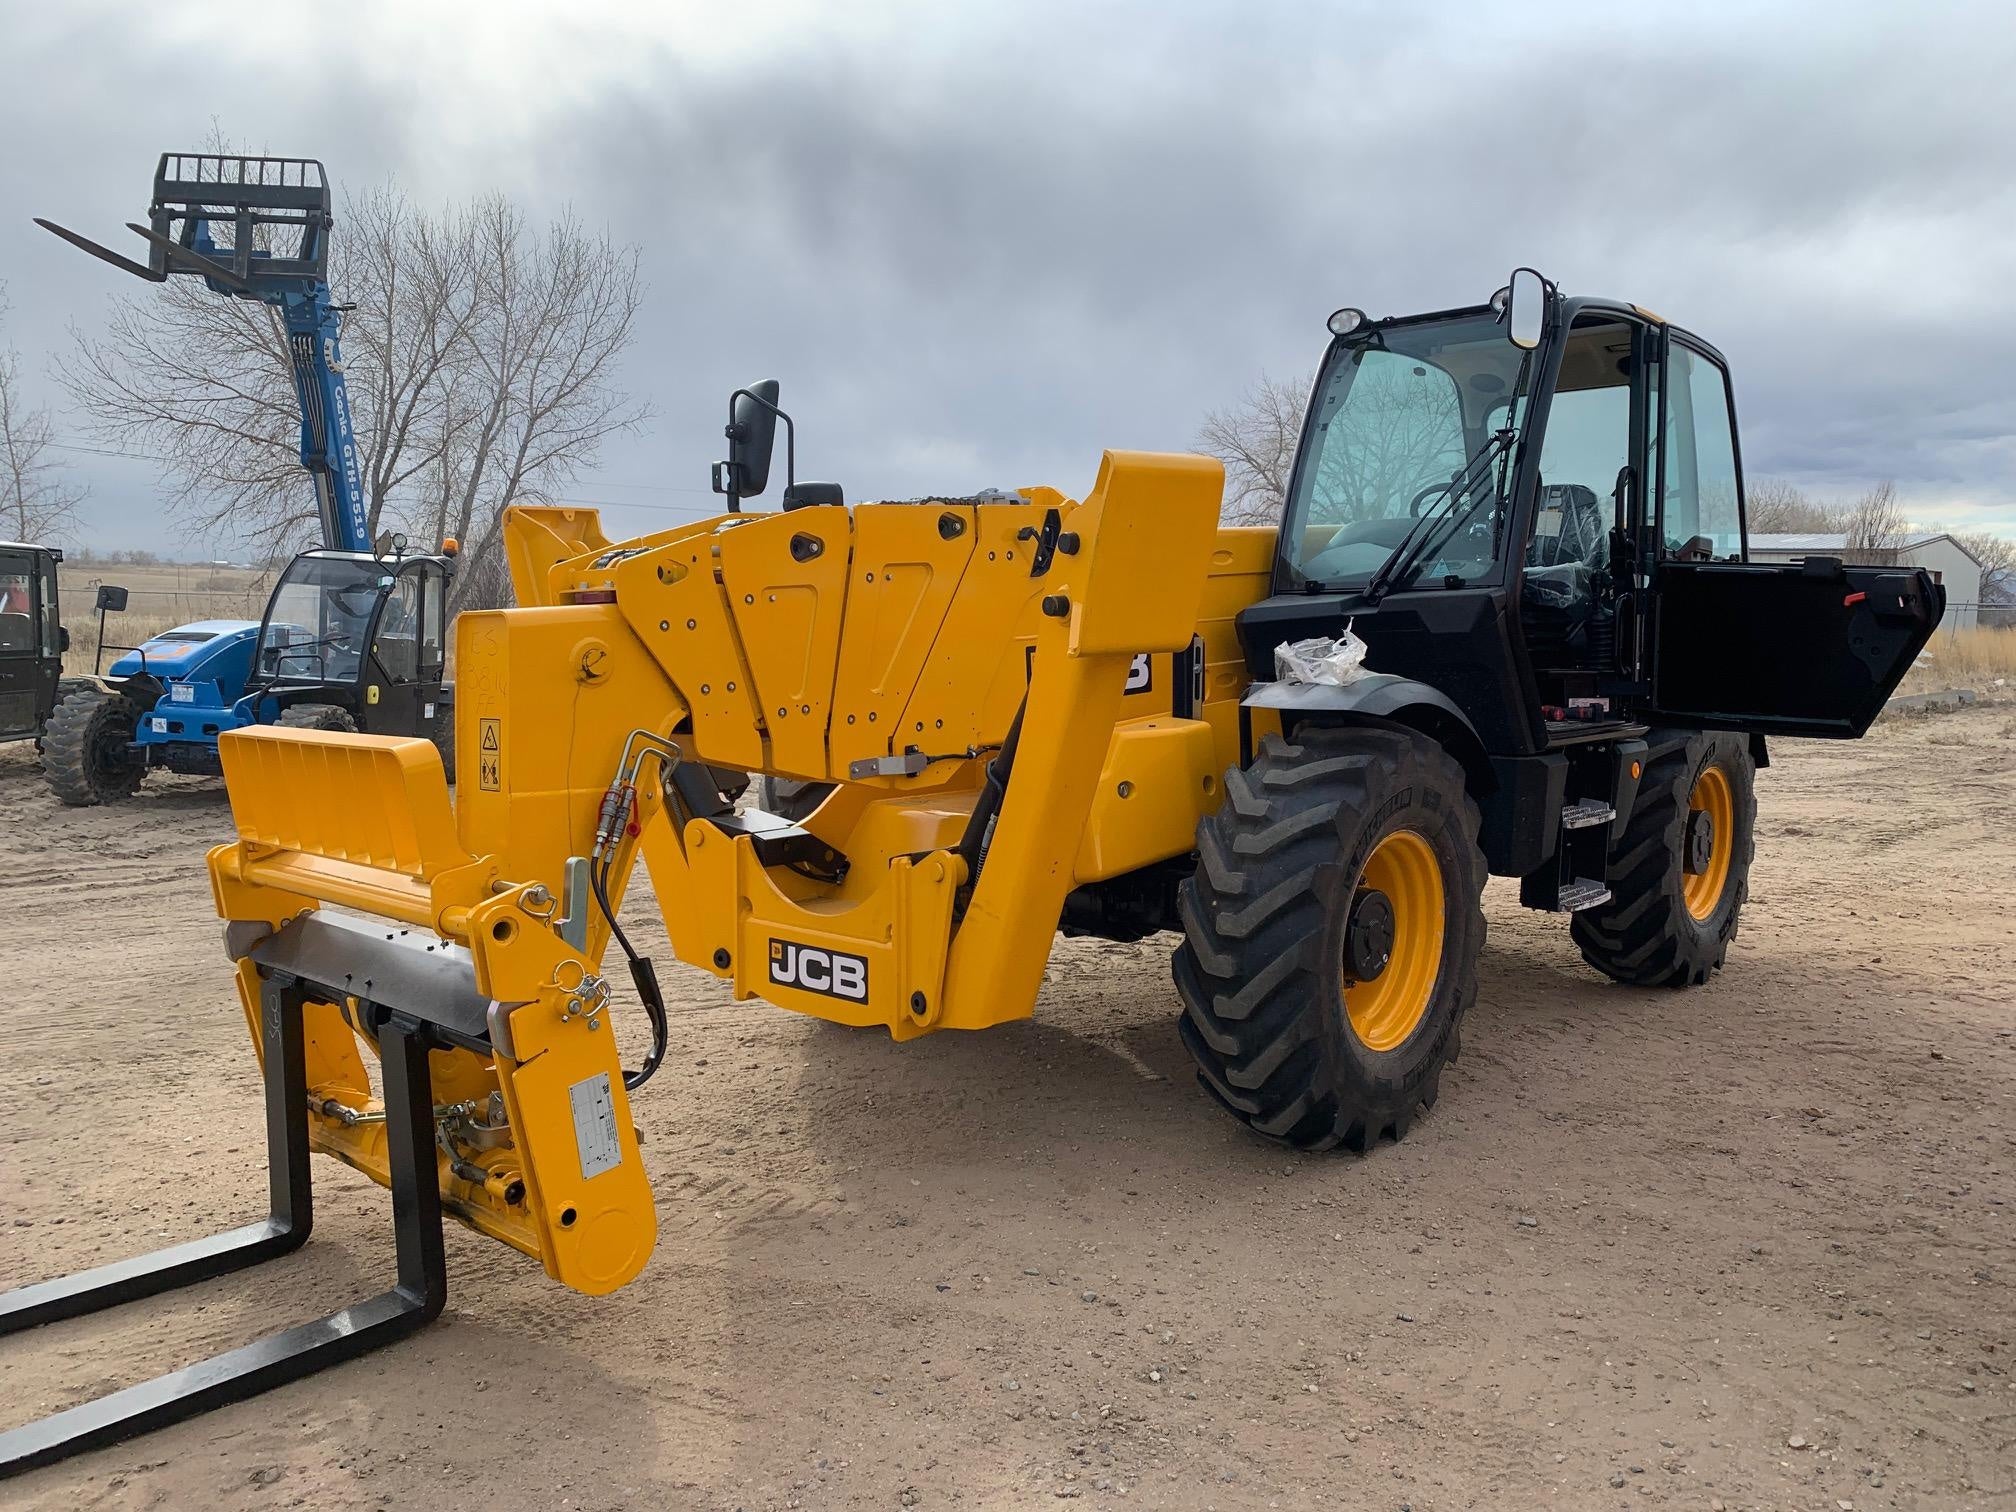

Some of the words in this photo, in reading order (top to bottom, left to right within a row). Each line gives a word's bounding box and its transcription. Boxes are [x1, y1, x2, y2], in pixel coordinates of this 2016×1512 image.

[335, 385, 347, 437] Genie
[343, 444, 365, 539] GTH-5519
[771, 945, 866, 999] JCB
